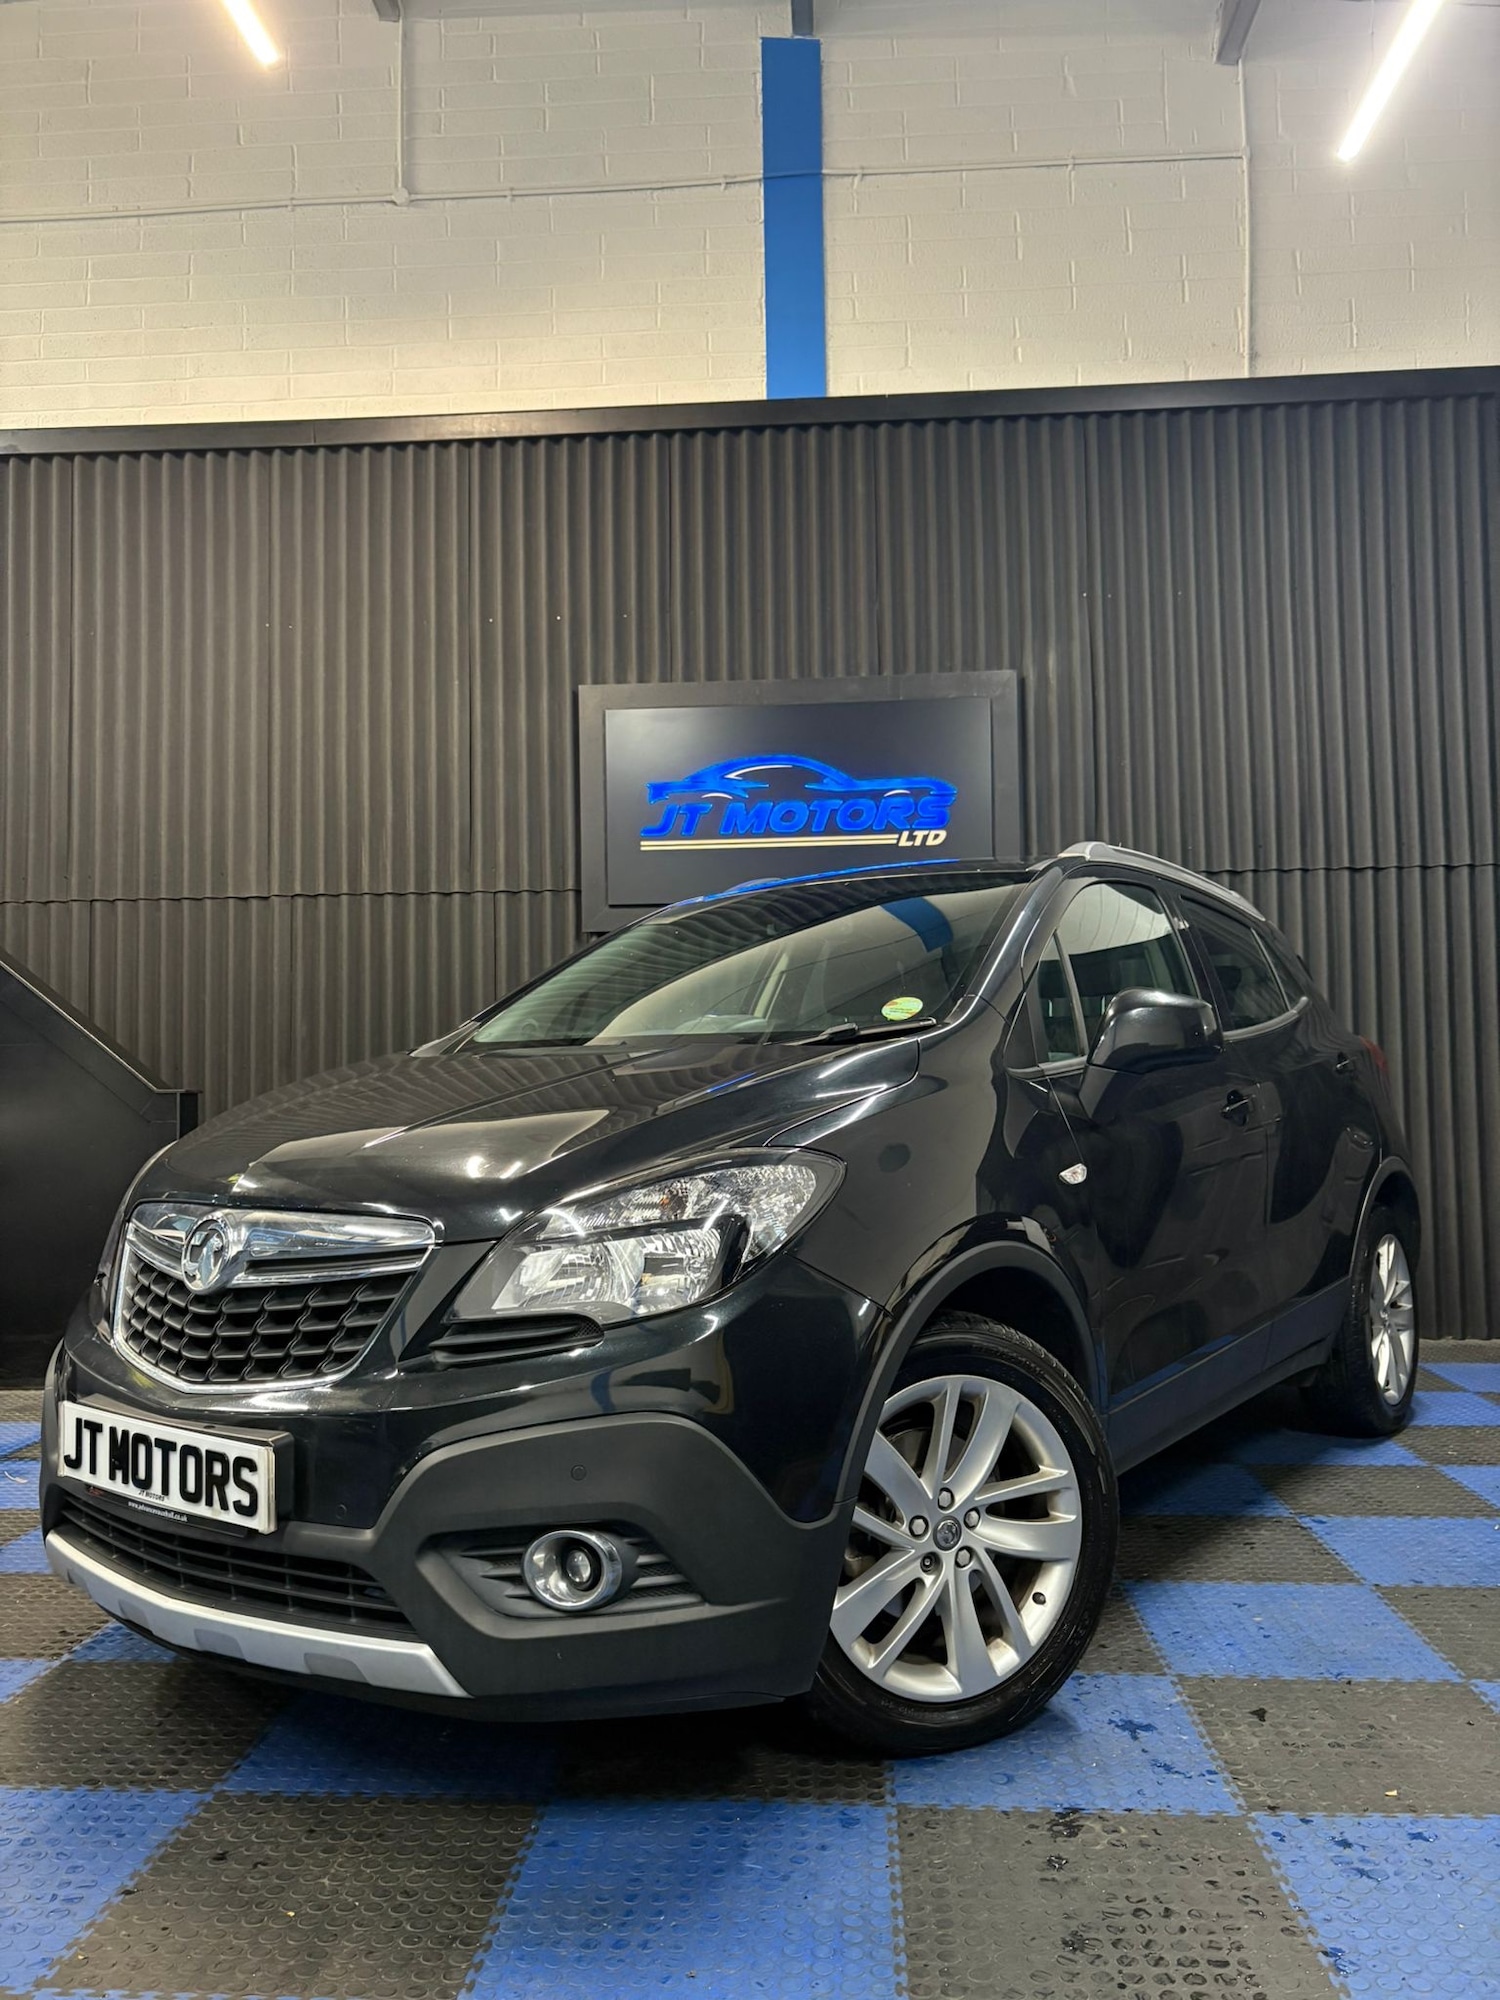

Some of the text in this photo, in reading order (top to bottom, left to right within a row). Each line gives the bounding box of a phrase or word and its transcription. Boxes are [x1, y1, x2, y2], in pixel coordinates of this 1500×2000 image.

[640, 796, 956, 836] JT MOTORS
[898, 829, 947, 847] LTD
[64, 1417, 258, 1517] JT MOTORS
